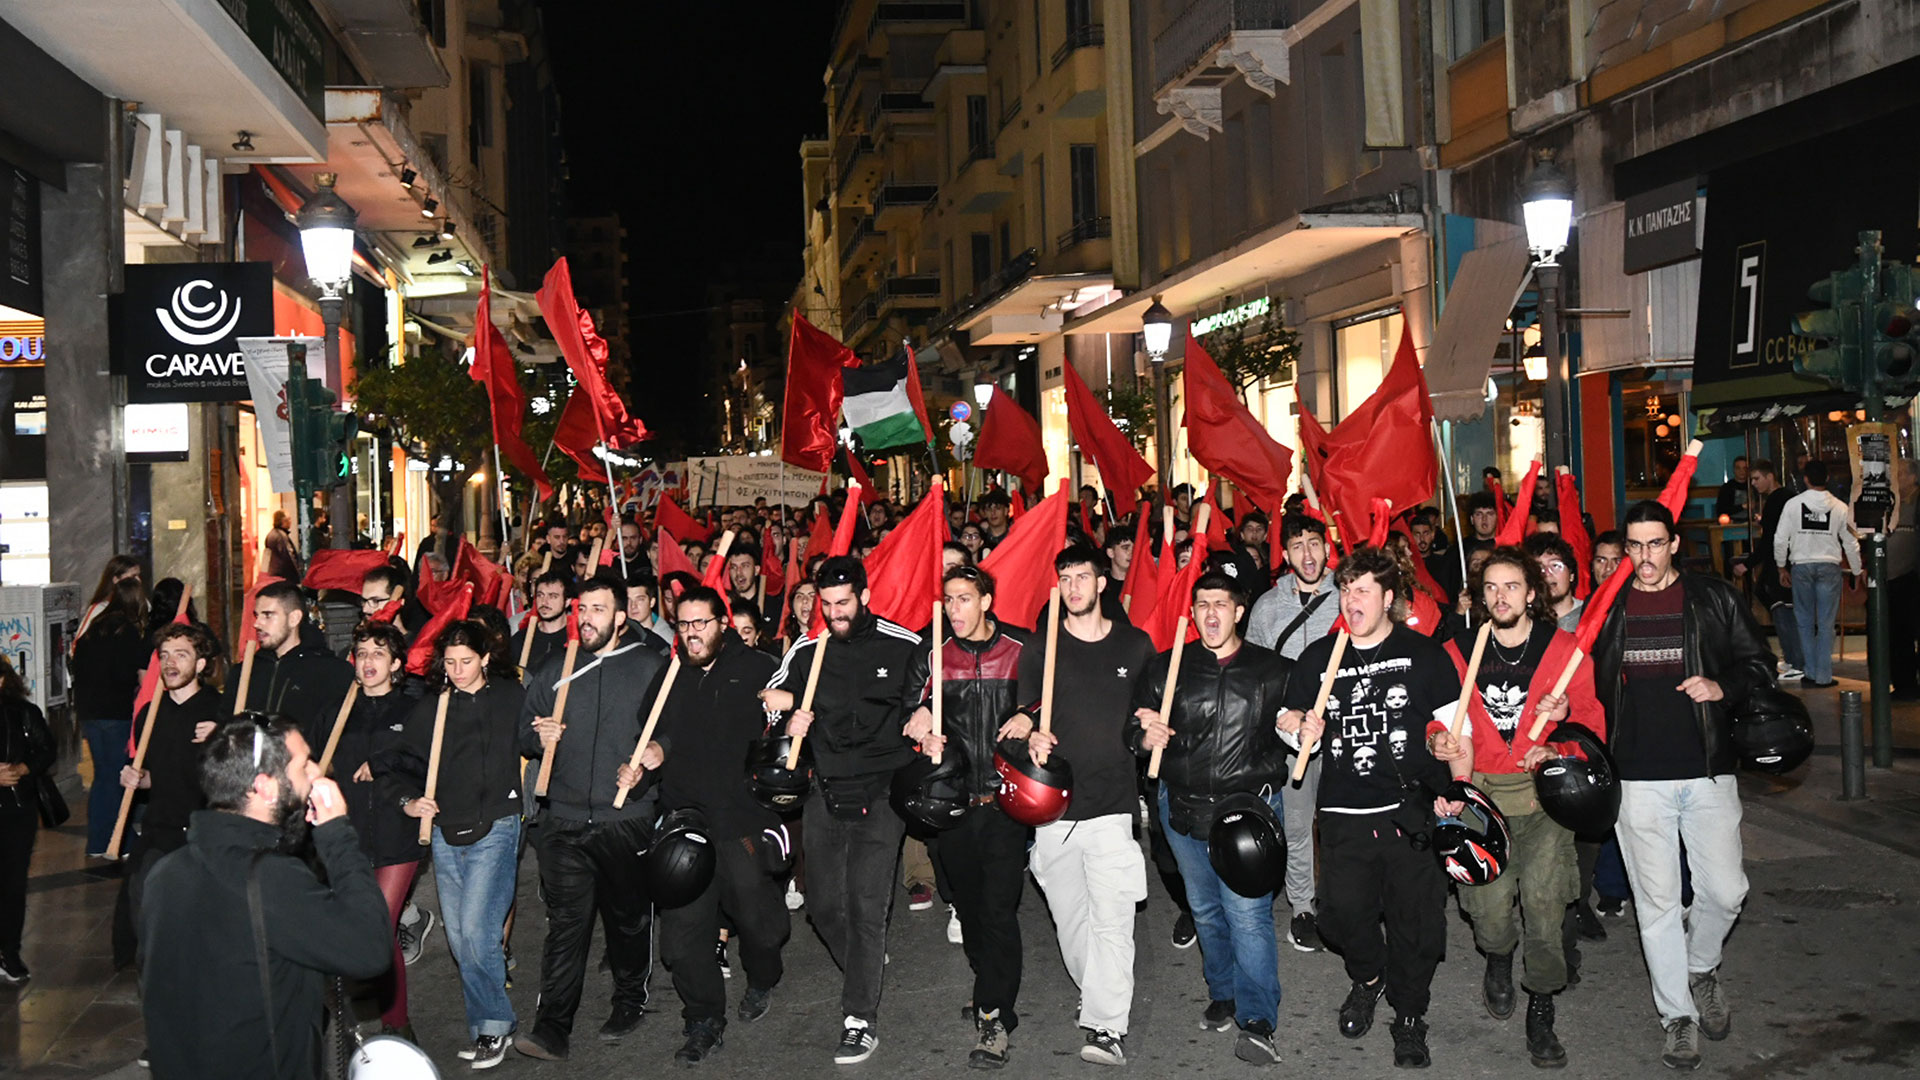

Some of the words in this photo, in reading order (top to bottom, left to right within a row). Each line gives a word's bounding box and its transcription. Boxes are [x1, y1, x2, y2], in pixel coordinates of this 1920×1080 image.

[1646, 200, 1692, 233] ΠΑΝΤΑΖΗΣ
[1765, 337, 1785, 364] CC
[145, 352, 246, 378] CARAVE
[172, 380, 200, 388] Sweets
[206, 380, 231, 388] makes
